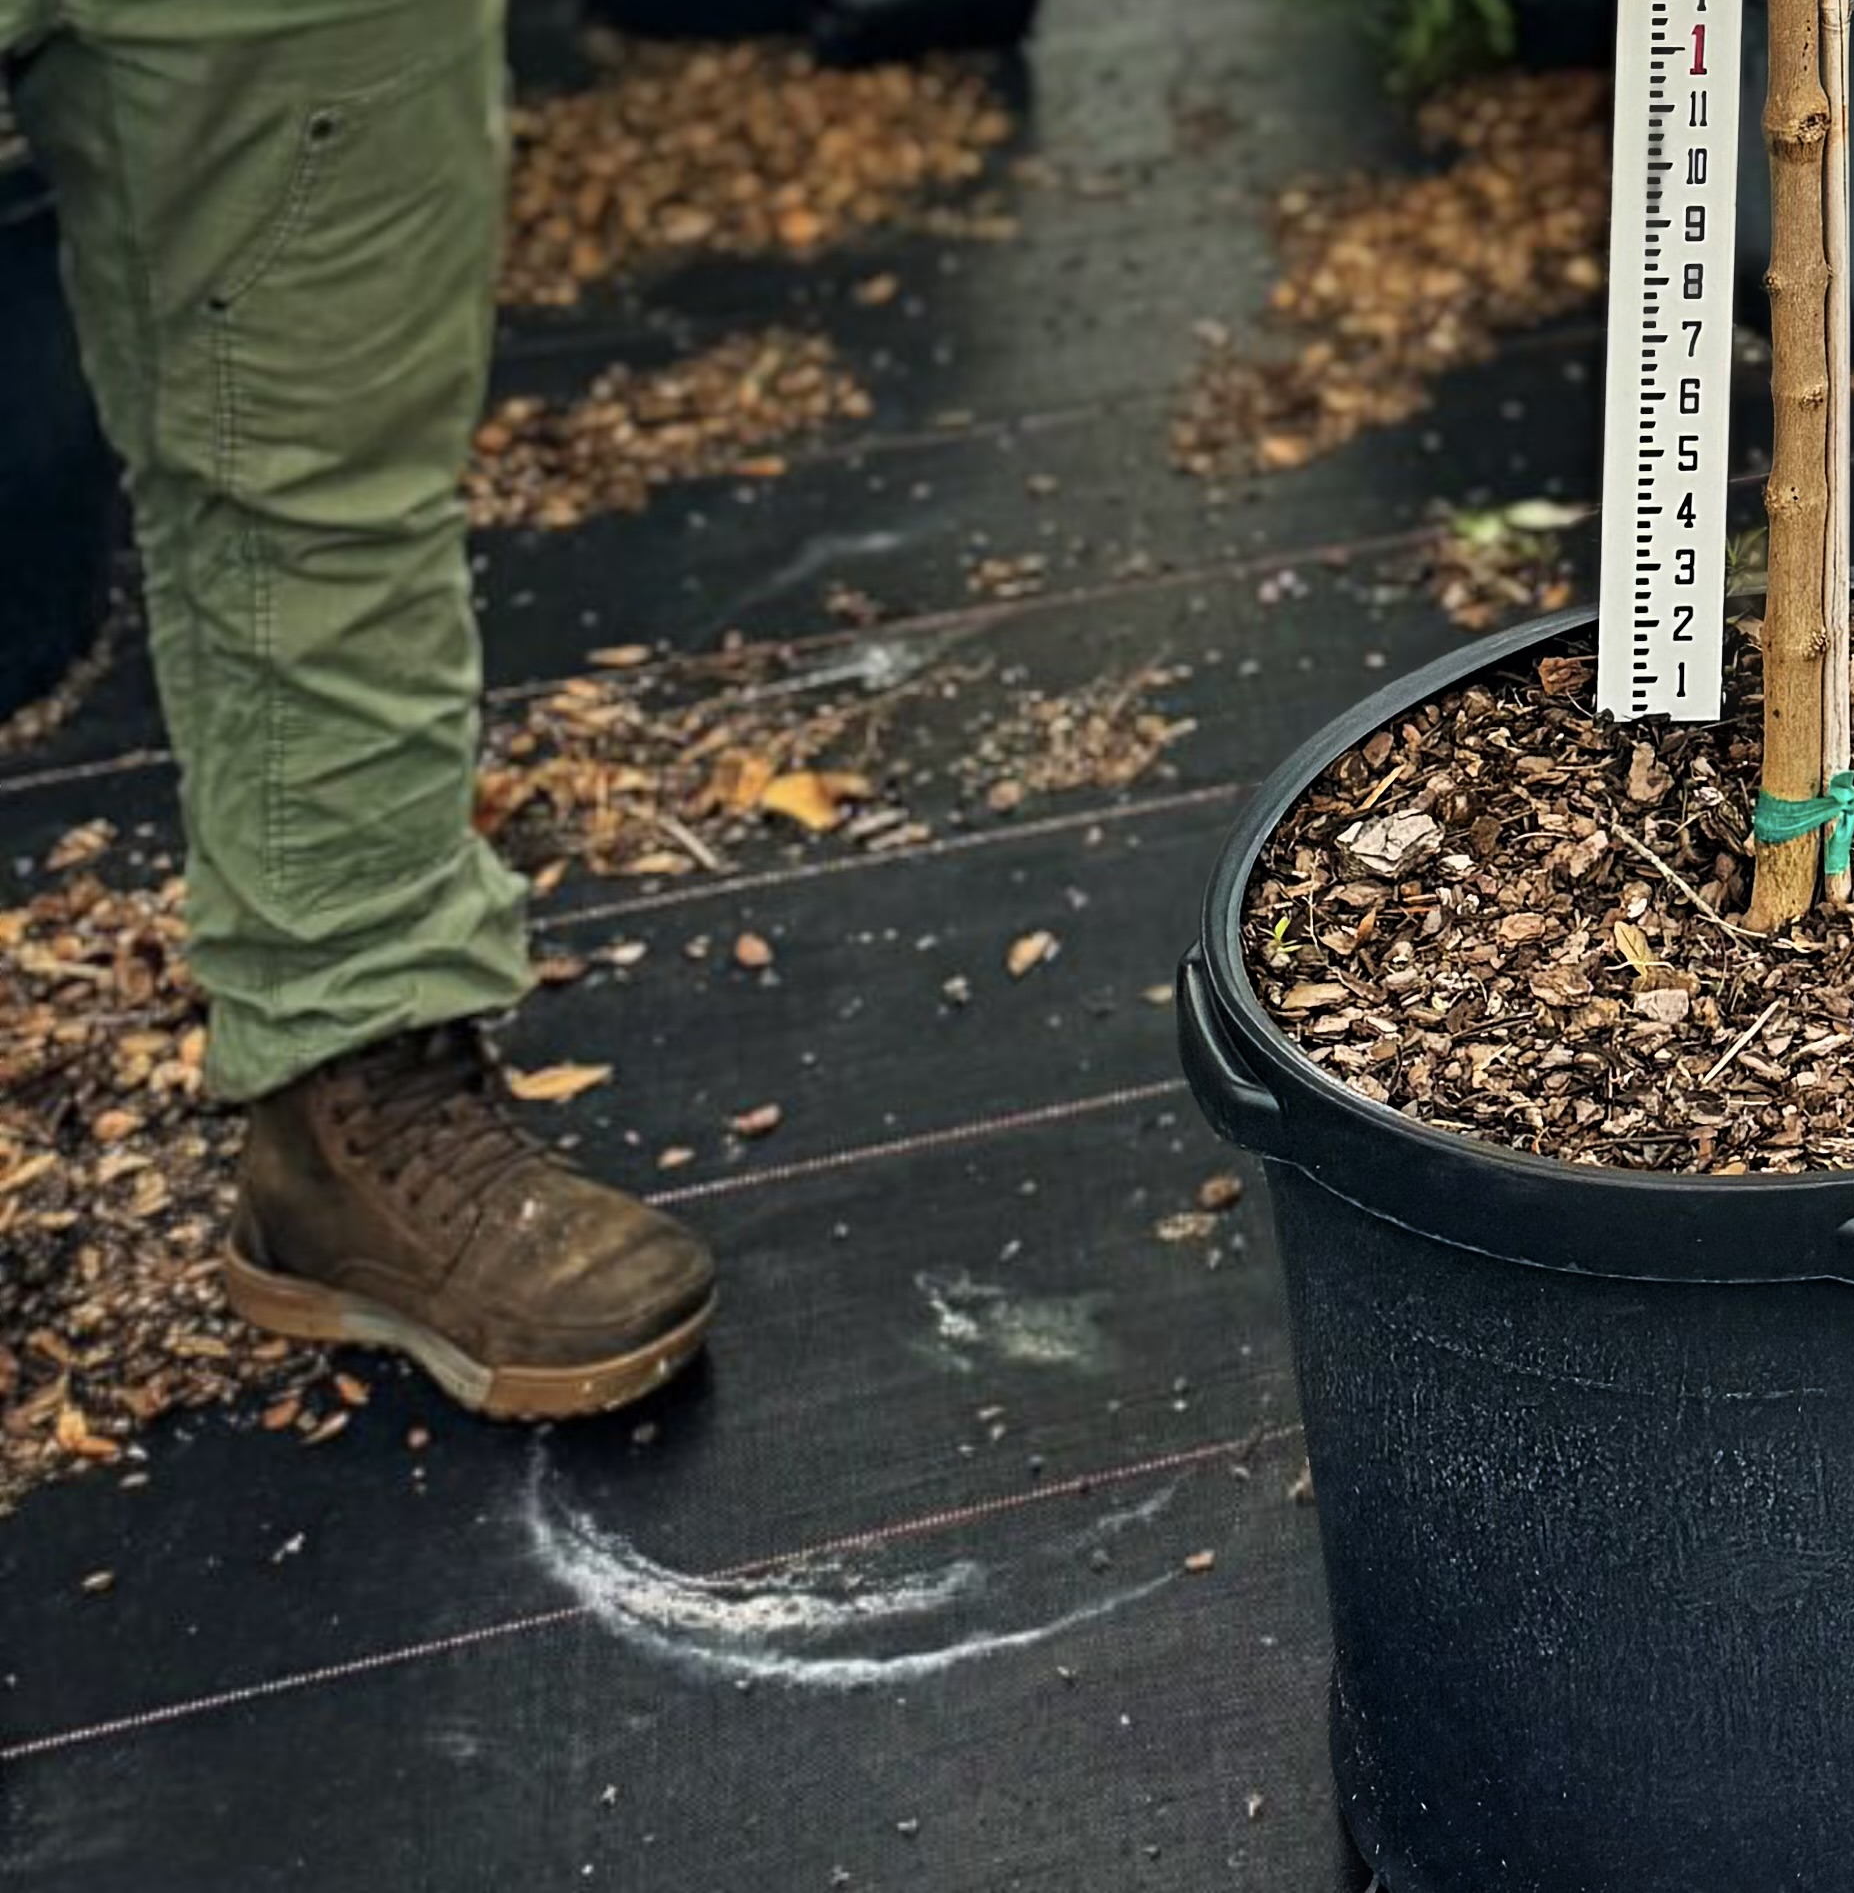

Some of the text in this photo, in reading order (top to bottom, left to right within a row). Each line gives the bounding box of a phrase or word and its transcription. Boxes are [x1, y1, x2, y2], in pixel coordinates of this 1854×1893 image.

[1690, 24, 1707, 75] 1
[1690, 91, 1707, 127] 11
[1687, 148, 1707, 185] 10
[1685, 206, 1705, 242] 9
[1683, 263, 1704, 300] 8
[1682, 320, 1702, 357] 7
[1680, 378, 1700, 414] 6
[1678, 435, 1699, 471] 5
[1677, 492, 1696, 528] 4
[1674, 549, 1695, 585] 3
[1672, 606, 1694, 642] 2
[1677, 662, 1685, 698] 1
